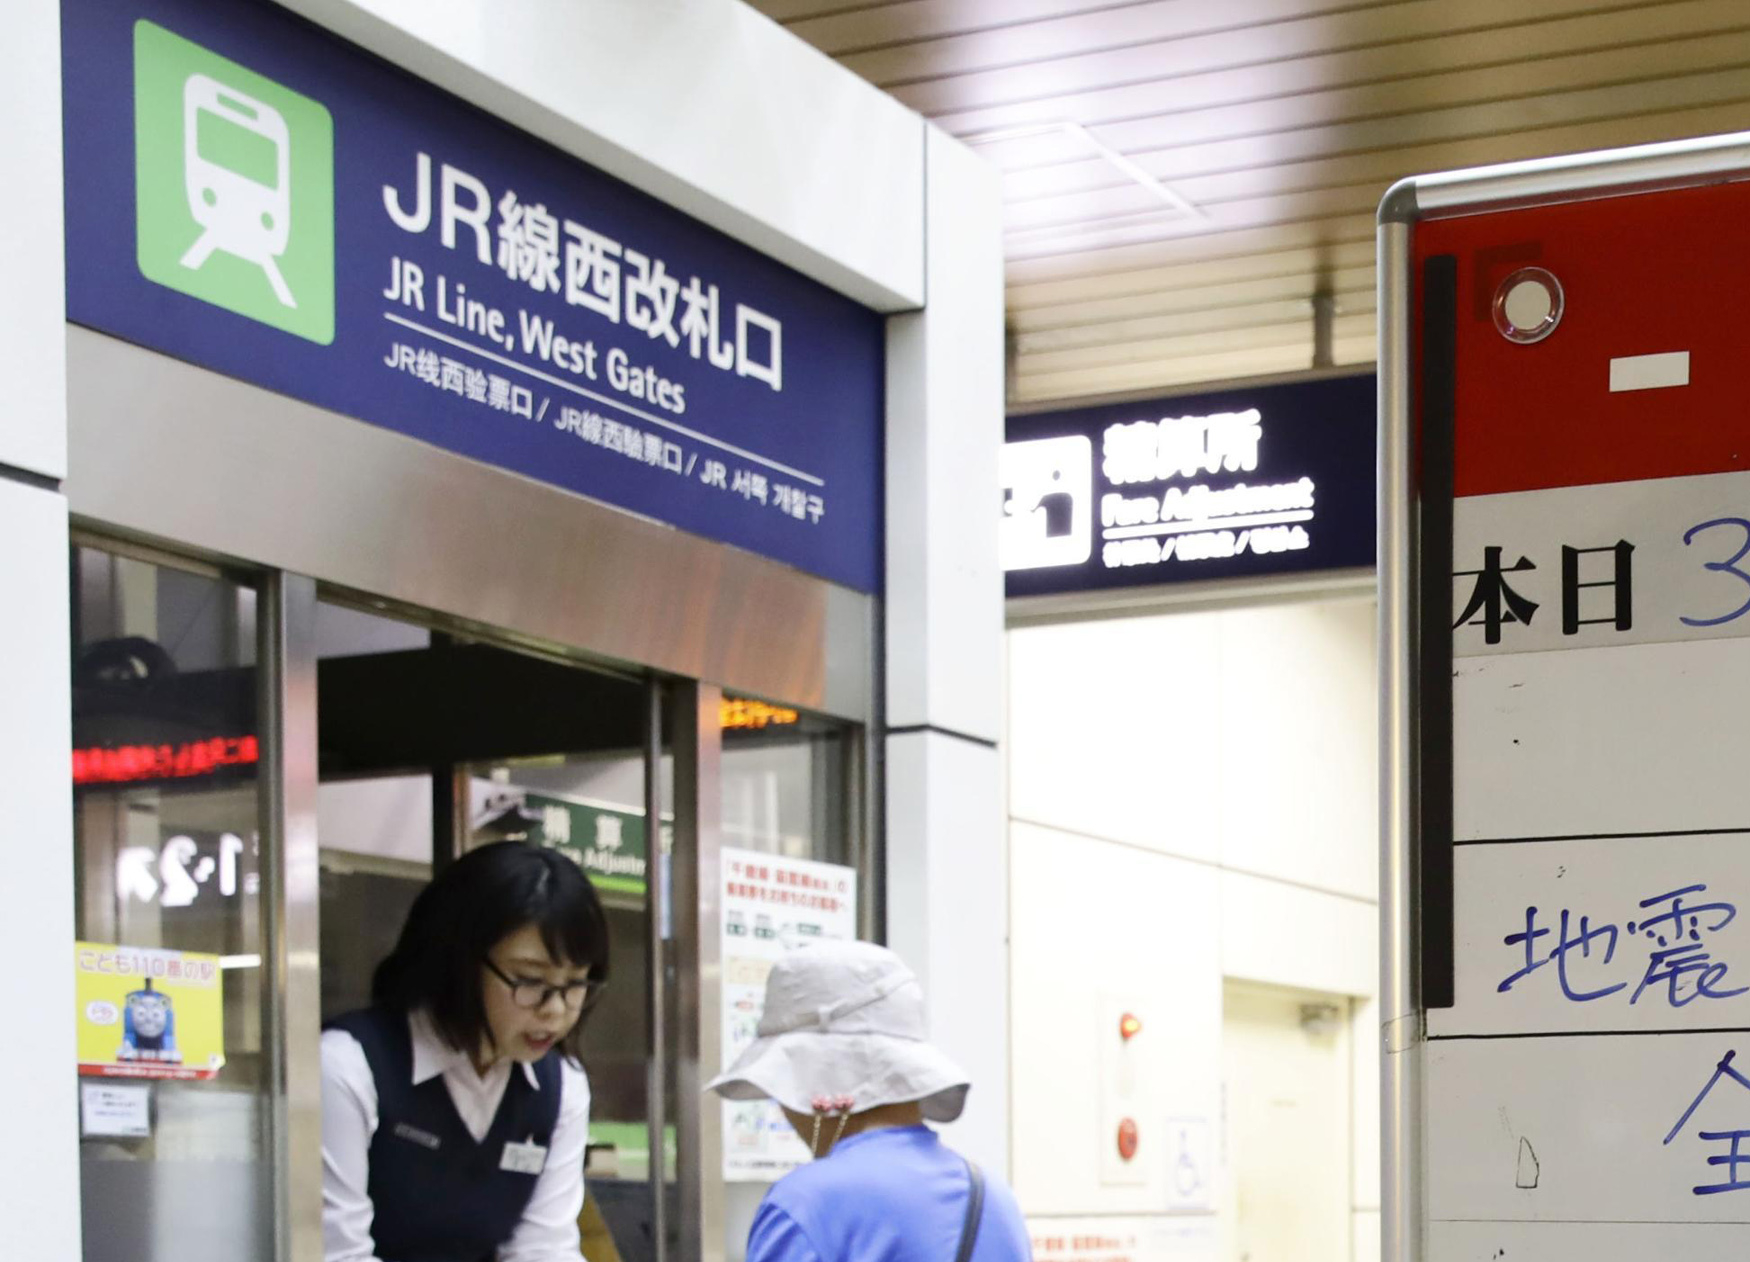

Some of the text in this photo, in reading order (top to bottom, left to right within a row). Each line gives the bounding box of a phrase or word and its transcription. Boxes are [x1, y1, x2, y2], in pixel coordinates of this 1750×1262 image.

[382, 150, 783, 392] JR線西改札口
[383, 255, 686, 416] JR Line, West Gates
